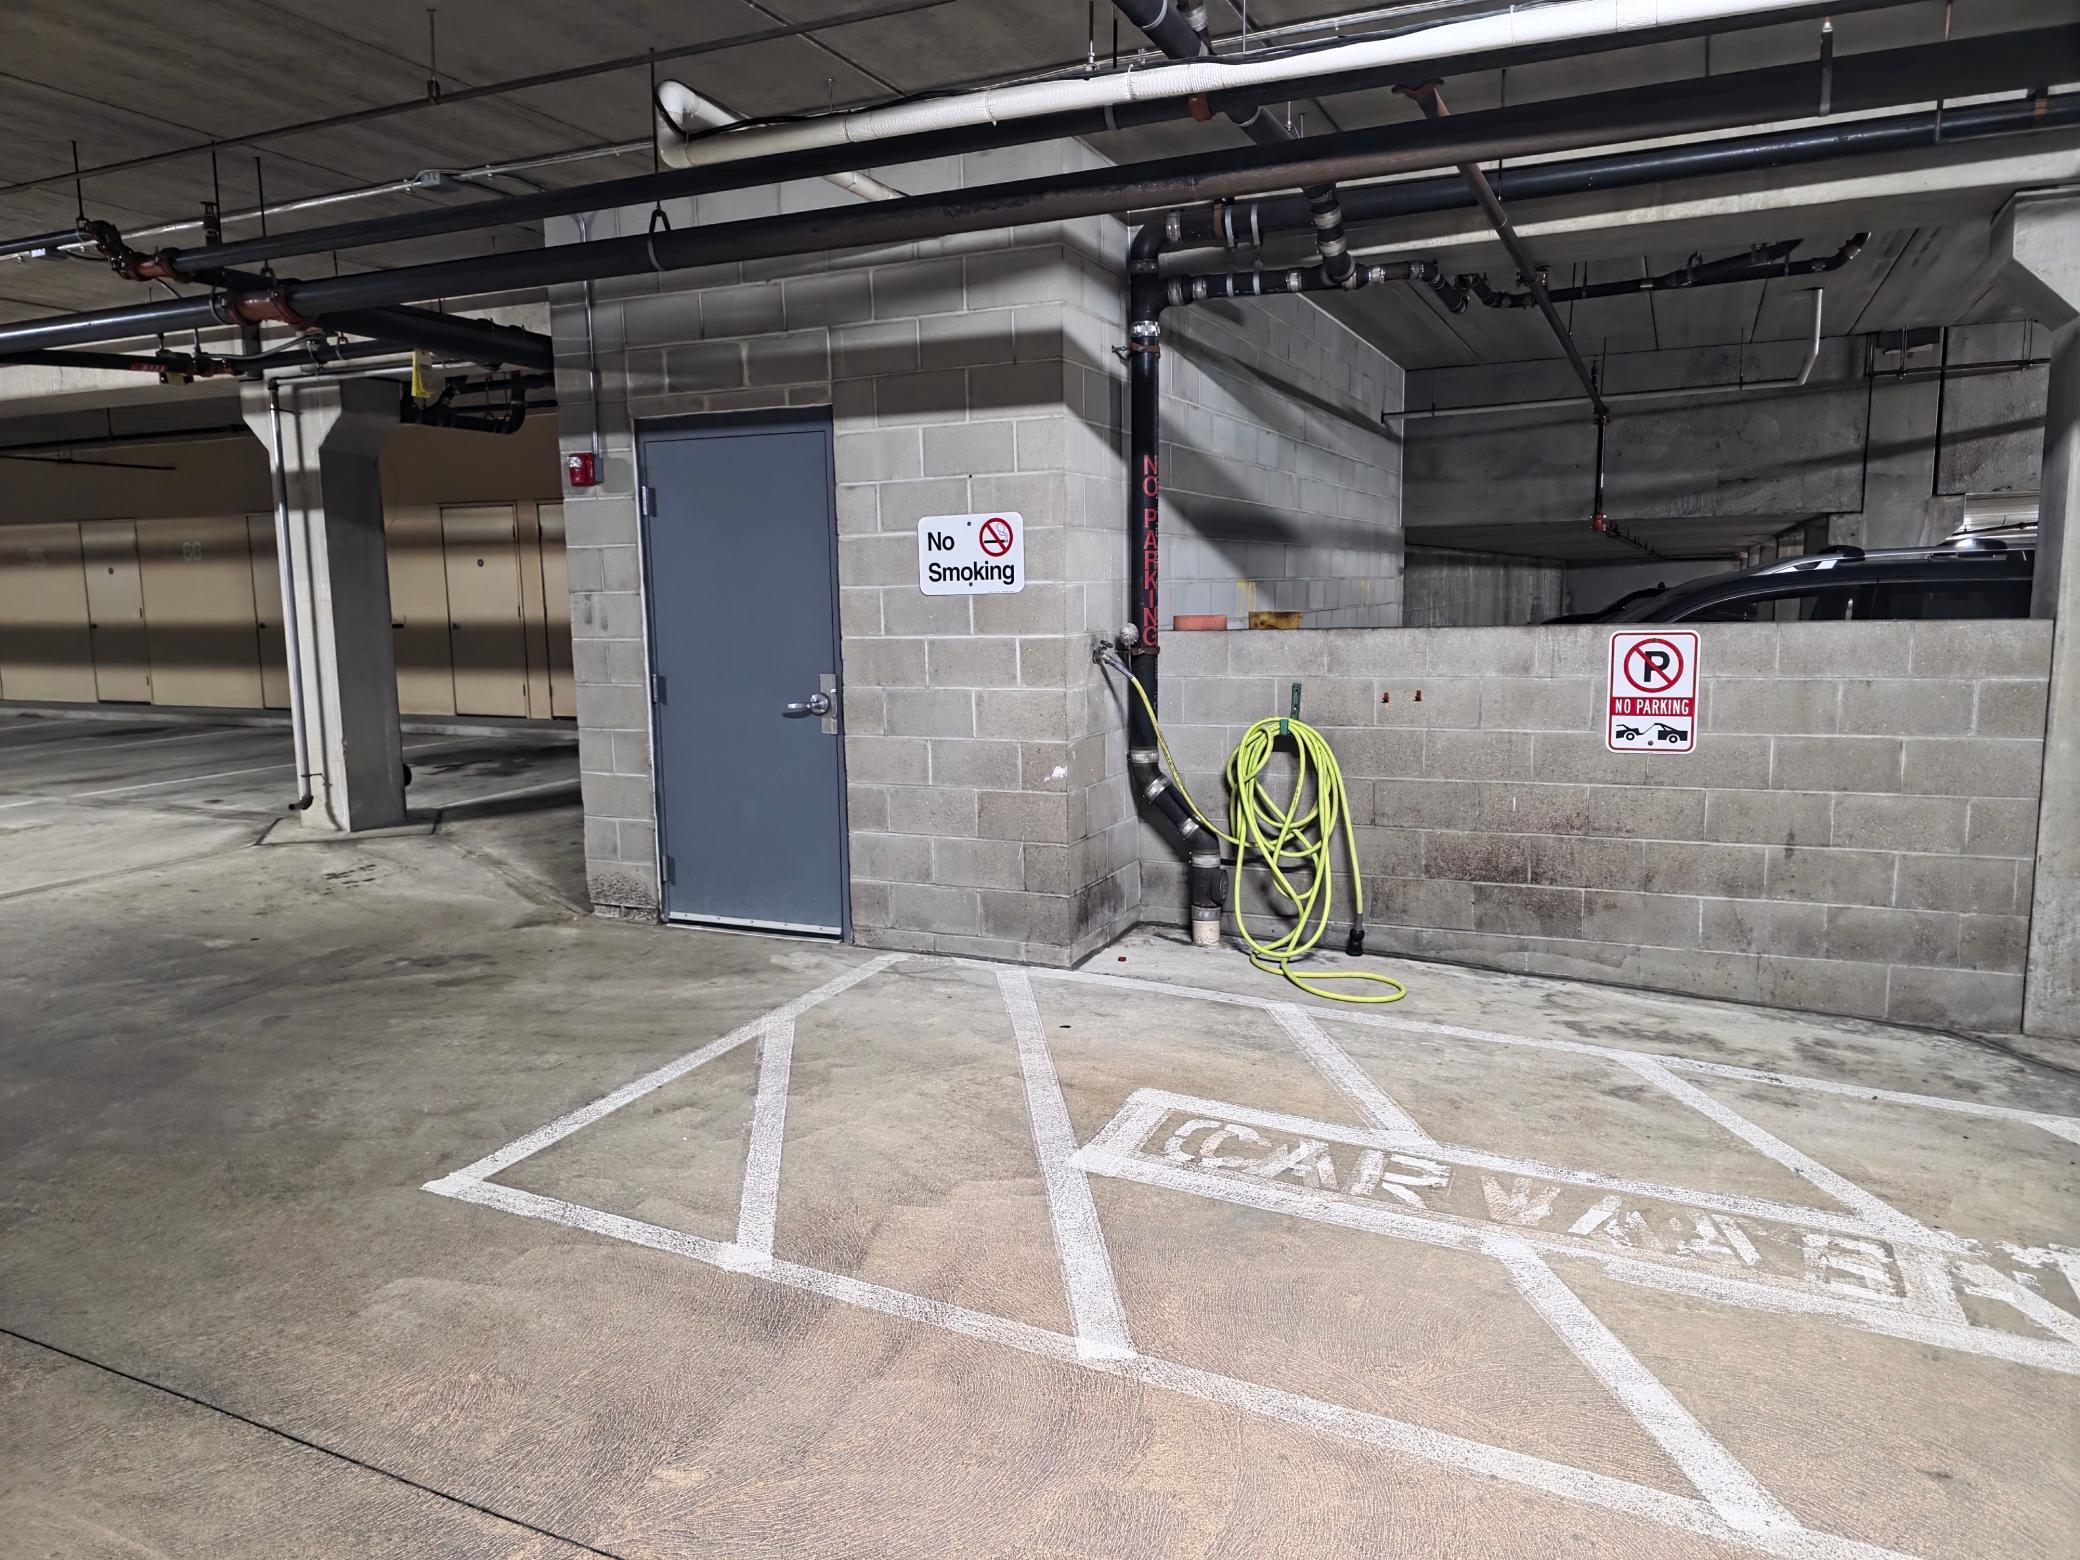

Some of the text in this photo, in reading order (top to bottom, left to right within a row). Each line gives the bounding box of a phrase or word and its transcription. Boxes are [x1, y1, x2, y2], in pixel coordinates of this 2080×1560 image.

[927, 531, 955, 551] No
[1142, 454, 1159, 647] NO PARKING
[928, 560, 1015, 585] Smoking
[1644, 651, 1670, 682] P
[1615, 699, 1689, 715] NO PARKING
